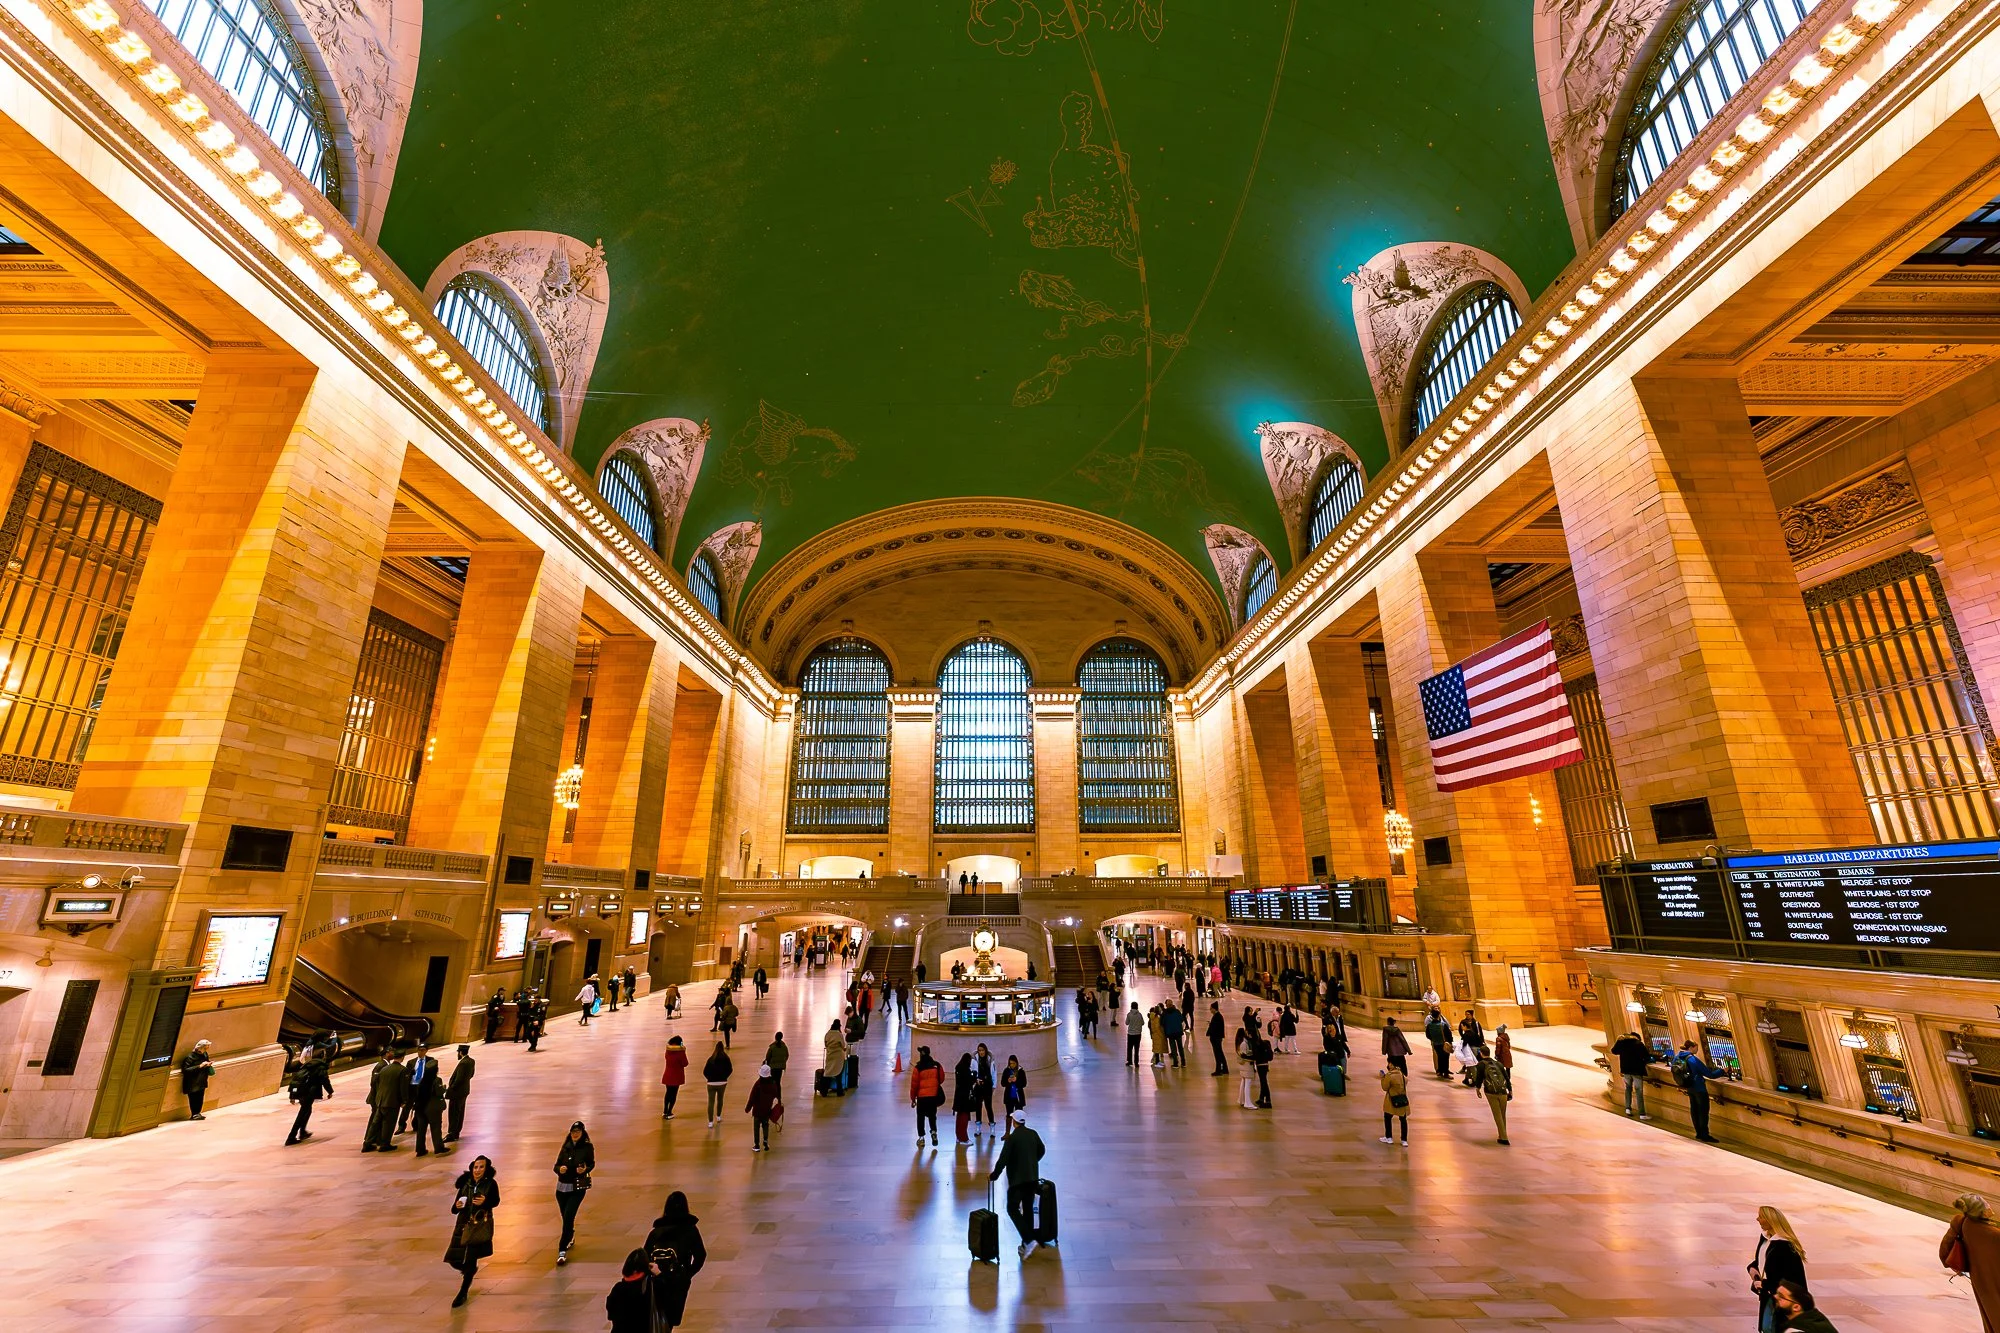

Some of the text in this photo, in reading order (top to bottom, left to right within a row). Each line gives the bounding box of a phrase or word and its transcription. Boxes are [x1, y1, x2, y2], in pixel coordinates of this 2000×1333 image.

[1784, 847, 1930, 864] HARLEM LINE DEPARTURES
[1651, 862, 1694, 870] INFORMATION
[1774, 870, 1820, 878] DESTINATION
[1838, 868, 1875, 876] REMARKS
[356, 909, 393, 923] BUILDING
[430, 911, 453, 924] STREET
[1853, 923, 1900, 931] CONNECTION
[1911, 925, 1947, 933] WASSAIC
[1790, 932, 1829, 940] CRESTWOOD
